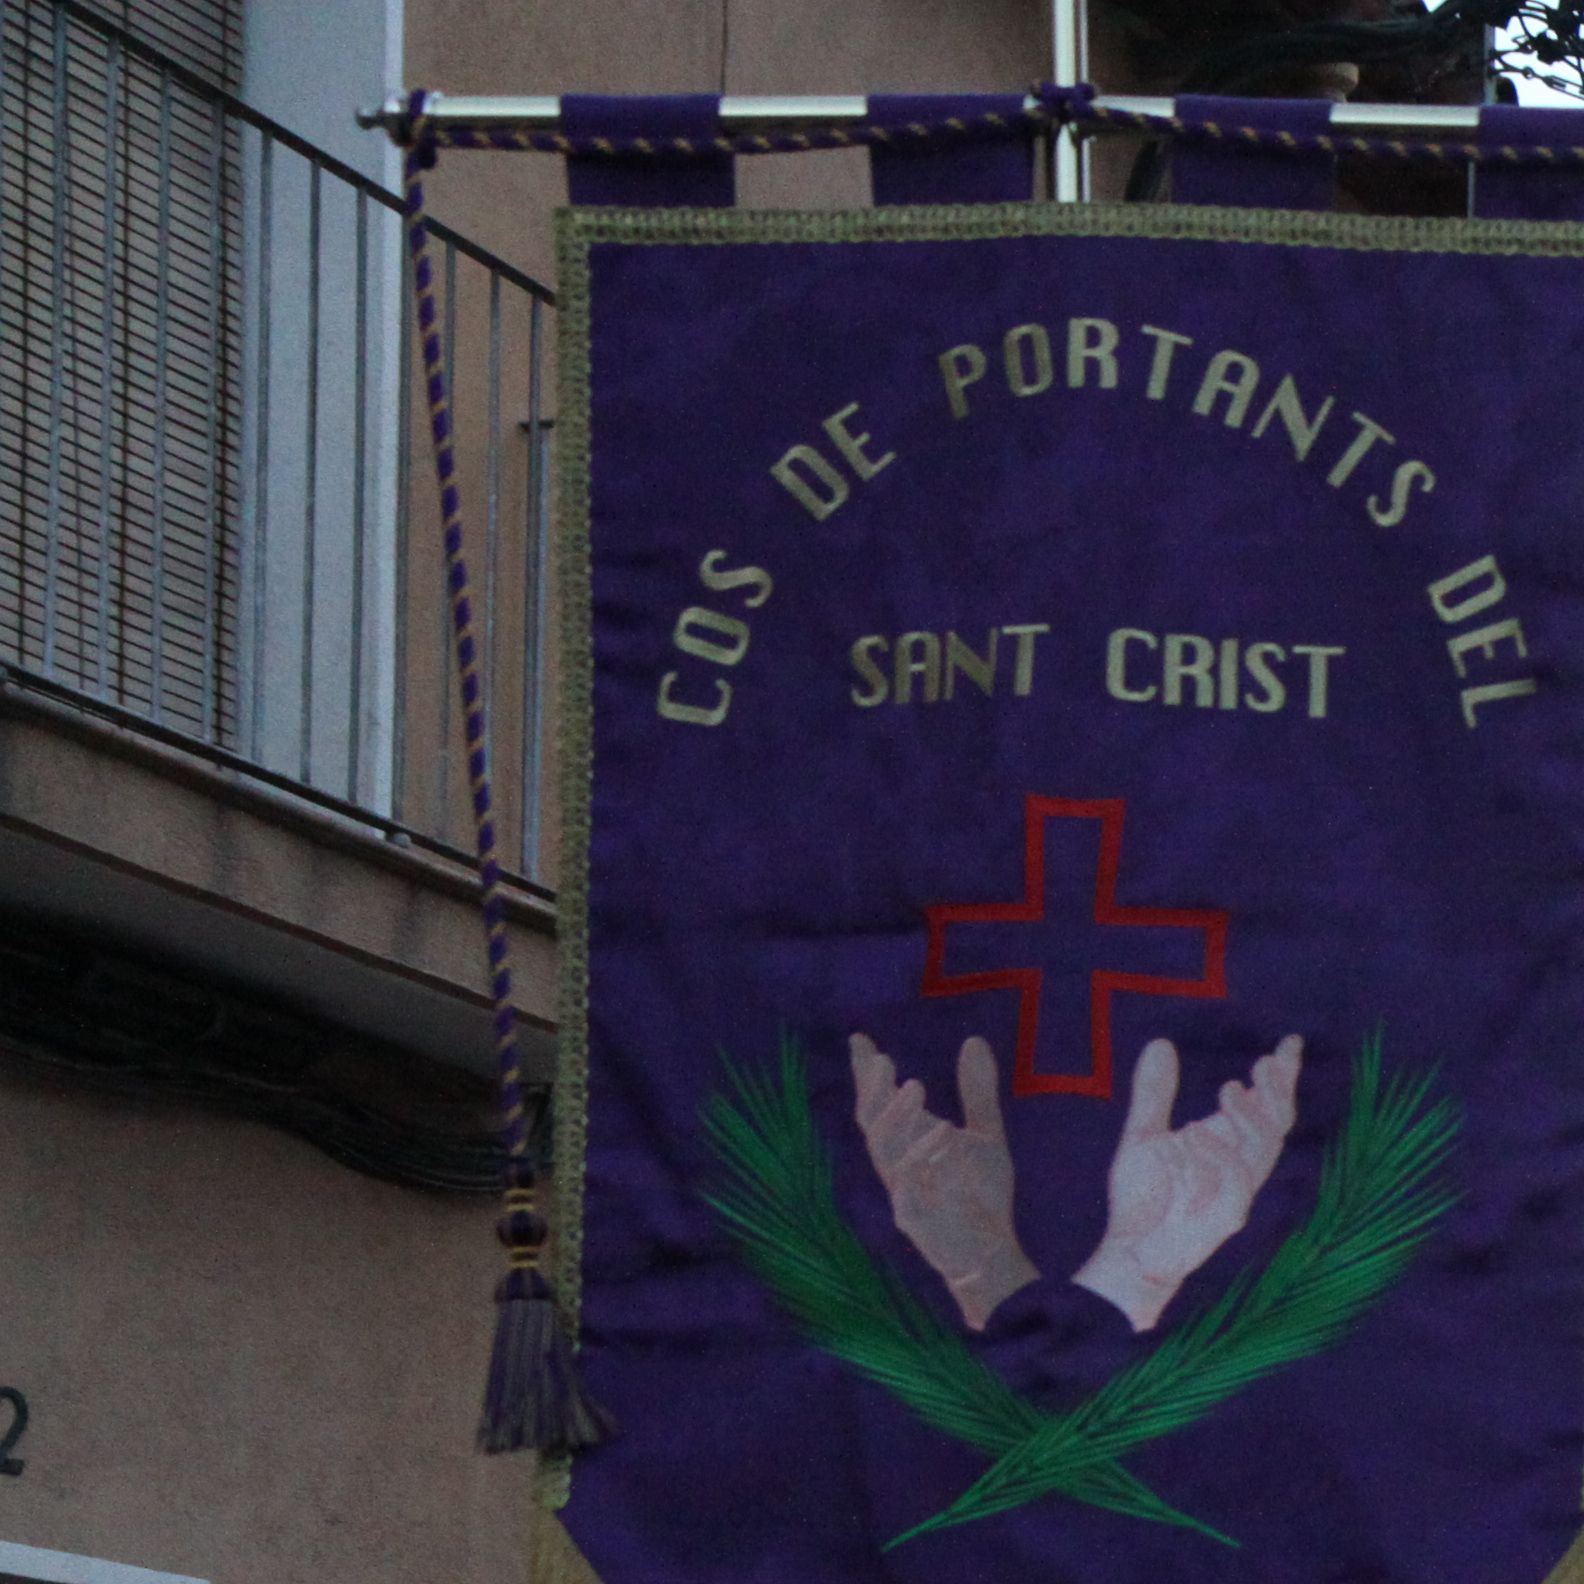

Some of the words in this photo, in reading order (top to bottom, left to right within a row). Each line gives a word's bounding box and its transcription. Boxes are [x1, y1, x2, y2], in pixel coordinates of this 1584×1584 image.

[657, 549, 774, 727] COS
[770, 402, 896, 522] DE
[938, 317, 1435, 528] PORTANTS
[1427, 554, 1537, 729] DEL
[850, 623, 1050, 708] SANT
[1106, 627, 1346, 718] CRIST
